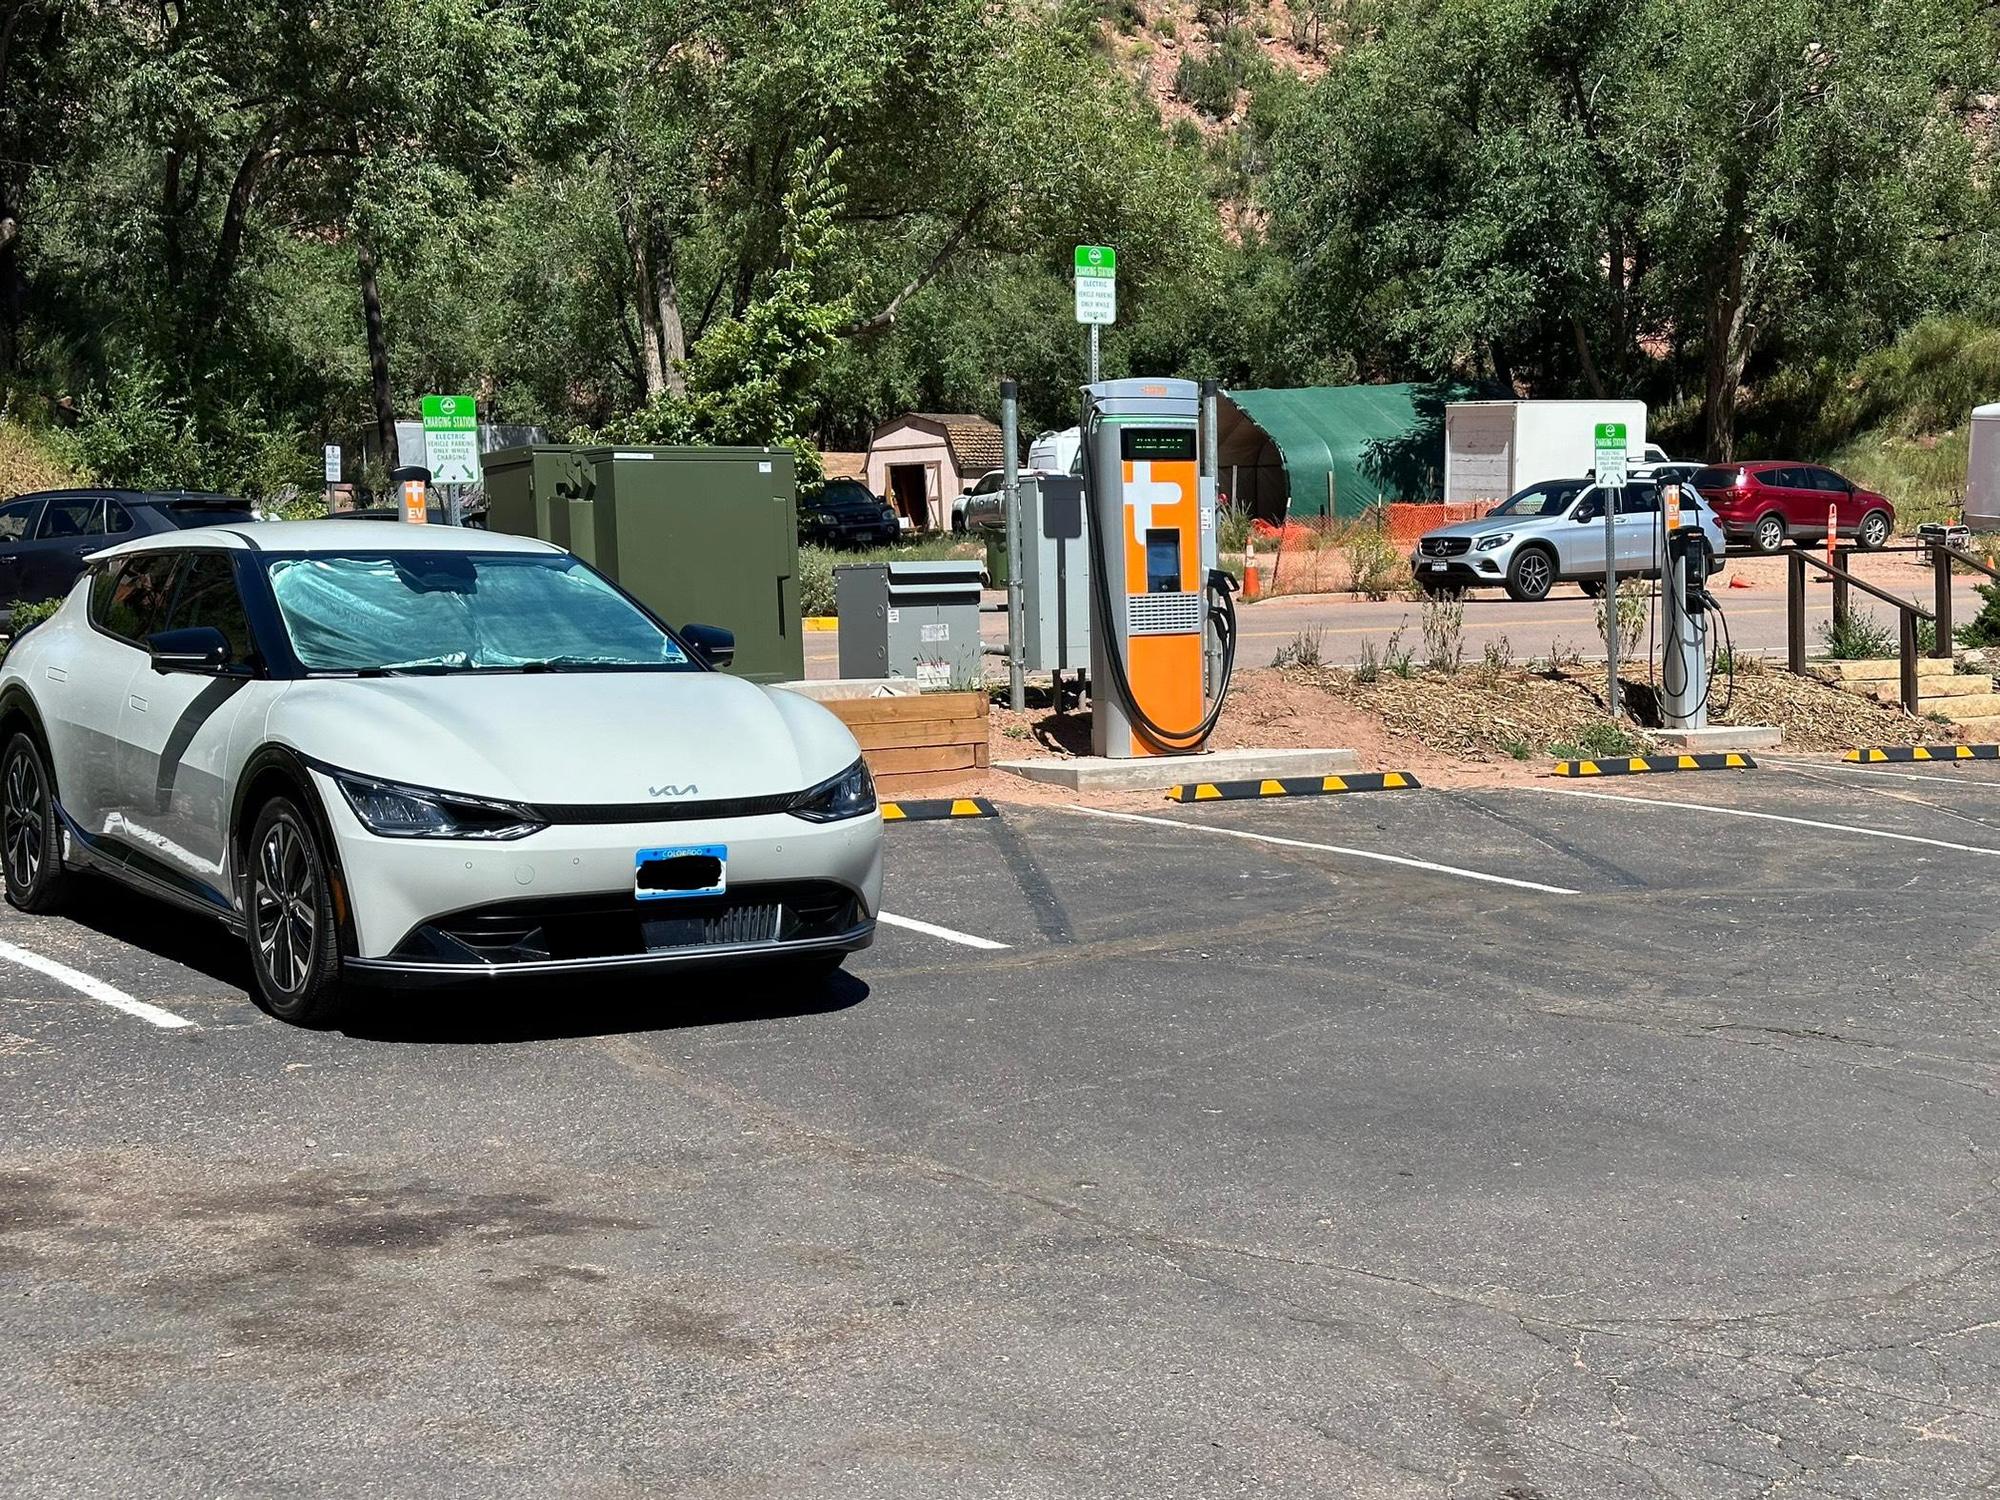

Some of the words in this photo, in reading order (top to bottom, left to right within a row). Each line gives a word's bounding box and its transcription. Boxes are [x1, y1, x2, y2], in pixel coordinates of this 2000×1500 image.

[1083, 280, 1108, 288] ELECTRIC
[425, 415, 452, 428] CHARGING
[453, 415, 477, 428] STATION
[407, 508, 425, 519] EV
[1669, 504, 1679, 513] EV
[648, 784, 698, 797] KIA
[661, 848, 703, 858] COLORADO
